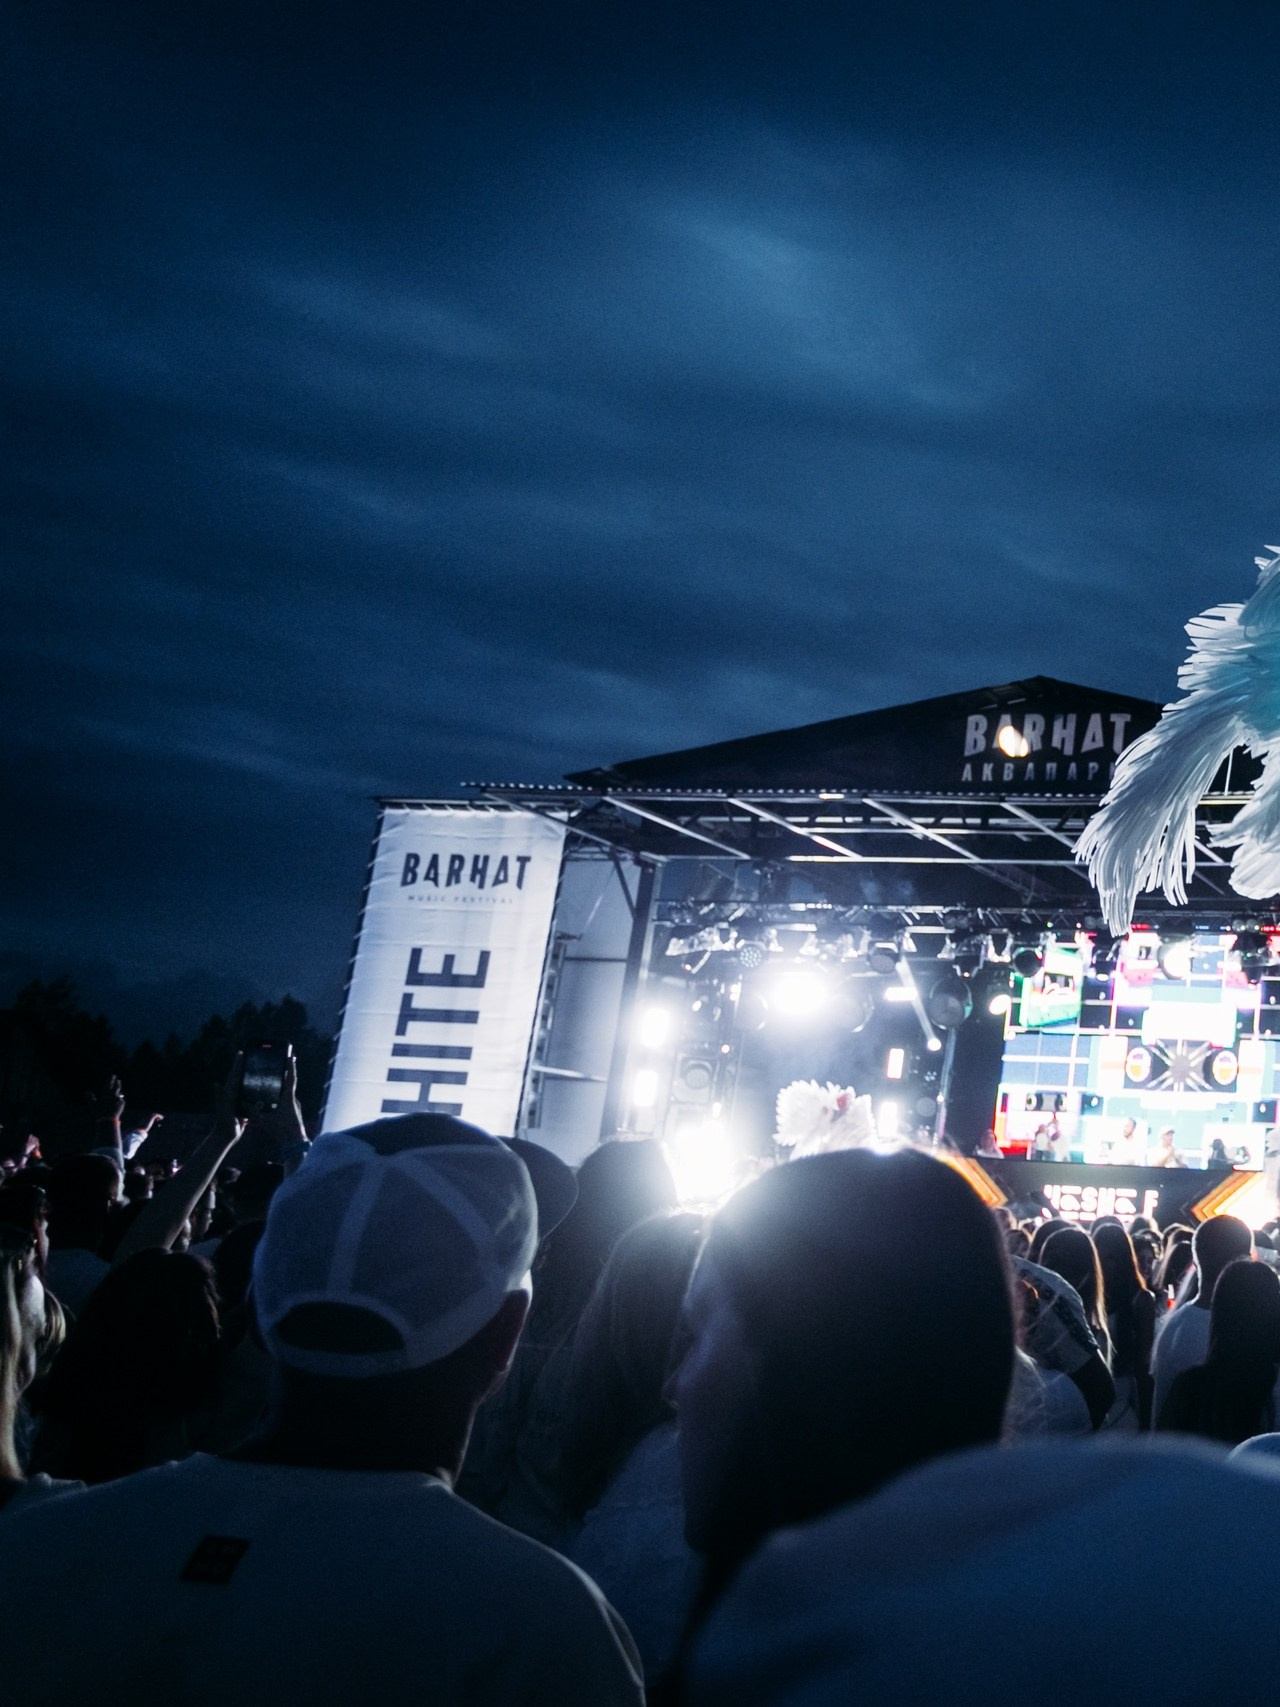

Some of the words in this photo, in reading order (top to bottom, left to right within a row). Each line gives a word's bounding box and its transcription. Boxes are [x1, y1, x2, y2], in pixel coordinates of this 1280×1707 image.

[400, 852, 532, 891] BARHAT
[408, 895, 446, 903] MUSIC
[454, 896, 513, 904] FESTIVAL
[381, 947, 491, 1117] HITE
